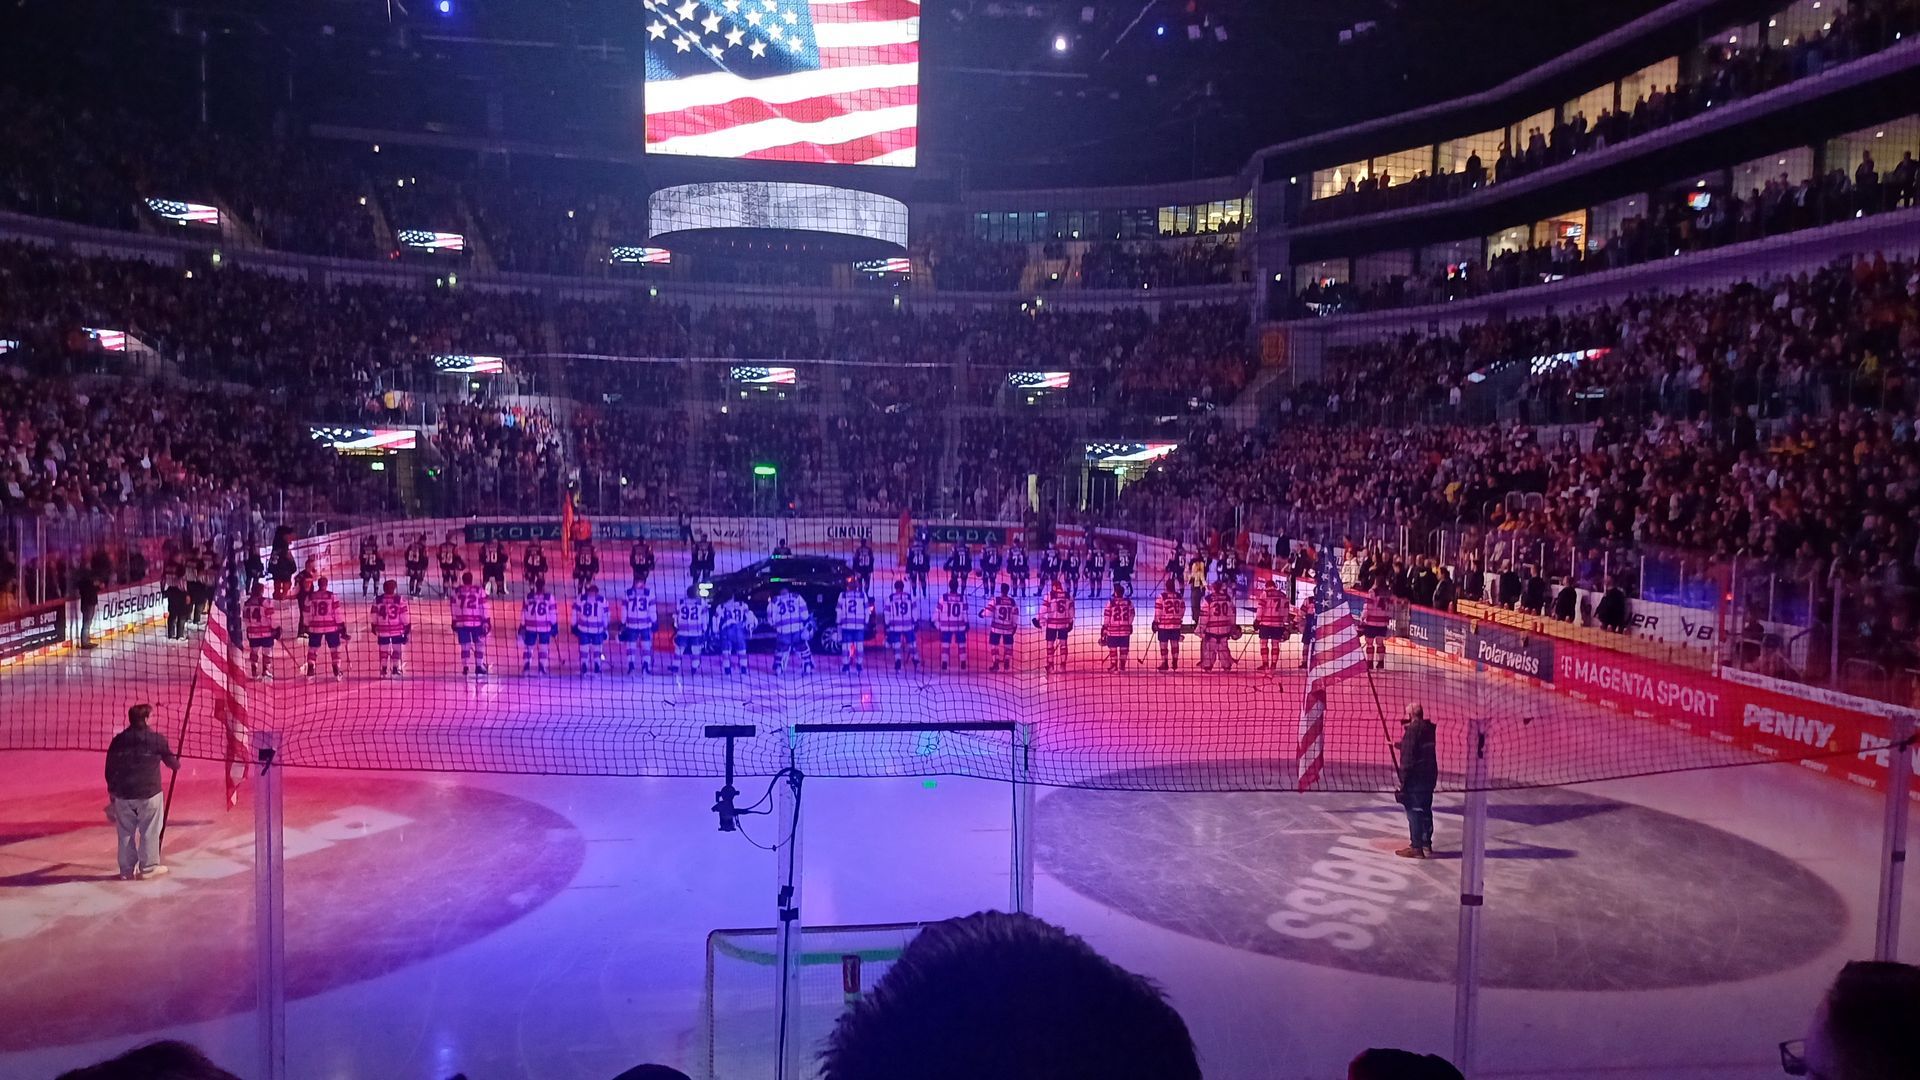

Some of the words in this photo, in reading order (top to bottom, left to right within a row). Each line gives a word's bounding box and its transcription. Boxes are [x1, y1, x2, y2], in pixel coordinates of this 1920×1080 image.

[930, 530, 997, 542] KODA
[458, 595, 477, 609] 72
[529, 601, 547, 616] 76
[629, 597, 647, 612] 73
[848, 600, 858, 613] 2
[894, 602, 909, 616] 19
[1212, 602, 1229, 616] 30
[947, 603, 961, 617] 10
[1478, 640, 1539, 675] Polarweiss
[1574, 657, 1655, 702] MAGENTA
[1657, 680, 1719, 718] SPORT
